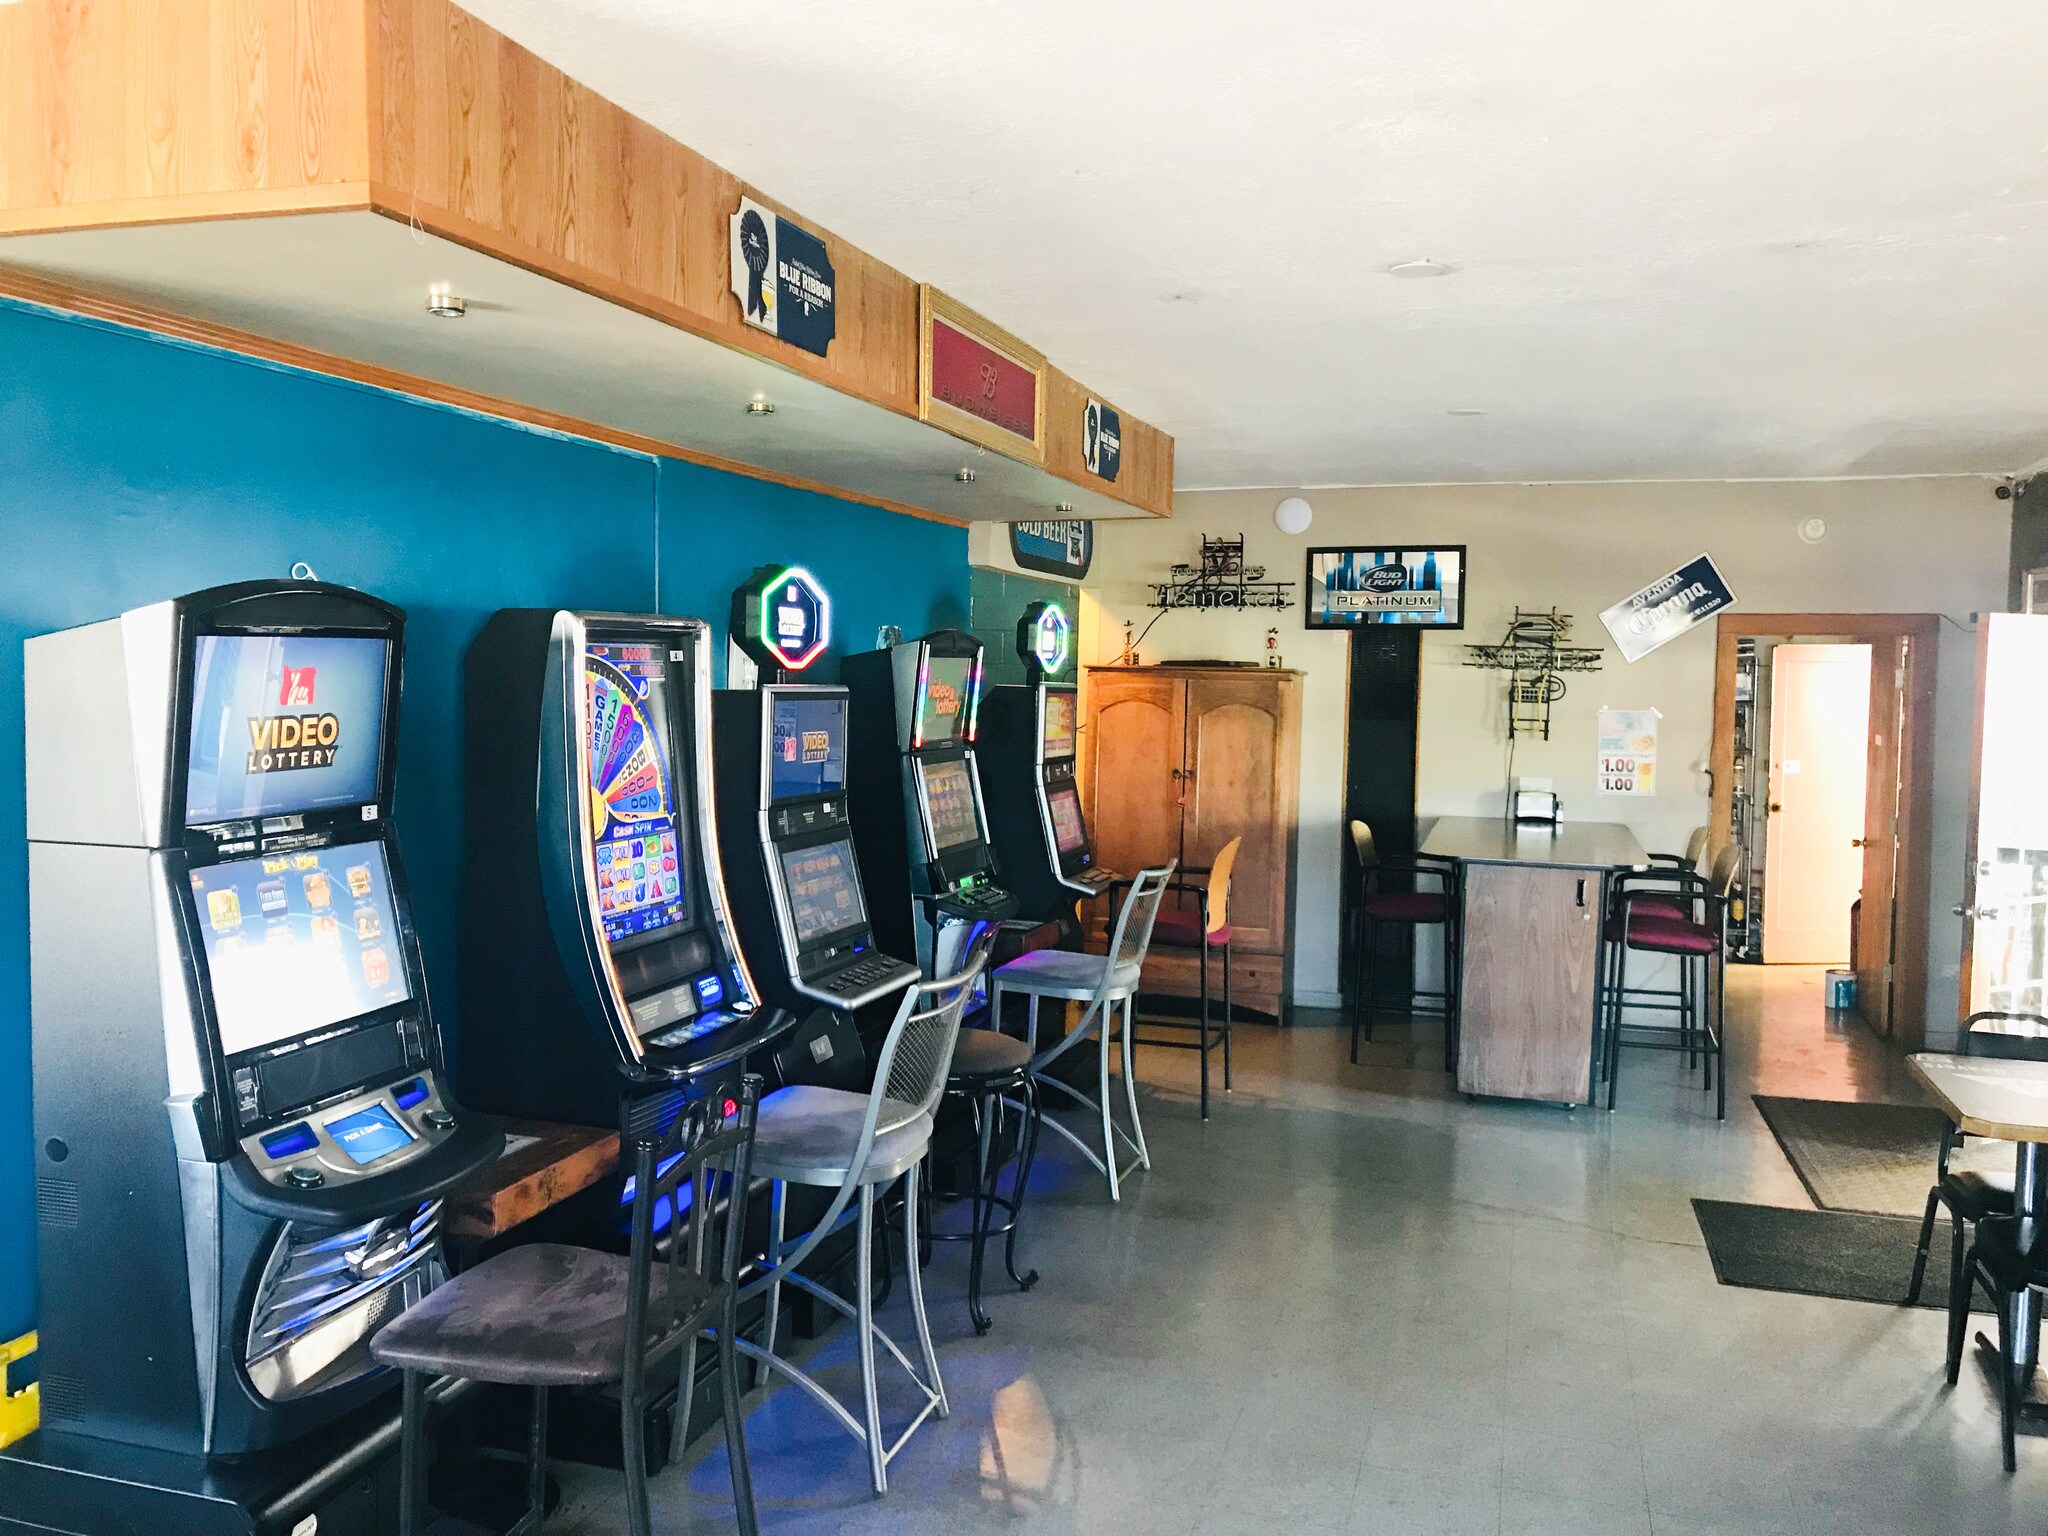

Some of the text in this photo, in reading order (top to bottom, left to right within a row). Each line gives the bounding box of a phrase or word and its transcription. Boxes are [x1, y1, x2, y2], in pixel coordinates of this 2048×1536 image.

[779, 260, 801, 289] BLUE
[802, 270, 832, 303] RIBBON
[1043, 521, 1067, 545] BEER
[1366, 578, 1406, 587] LIGHT
[1373, 570, 1402, 579] BUD
[1154, 584, 1287, 608] Heineken
[1336, 596, 1433, 606] PLATINUM
[1632, 574, 1683, 608] AVENIDA
[1629, 582, 1708, 635] Corona
[250, 715, 338, 751] VIDEO
[594, 694, 606, 751] GAMES
[601, 698, 618, 757] 1500
[803, 732, 828, 750] VIDEO
[248, 748, 335, 772] LOTTERY
[804, 750, 827, 760] LOTTERY
[613, 821, 652, 838] CASH SPIN
[343, 1131, 360, 1142] PICK
[365, 1121, 384, 1133] GAME
